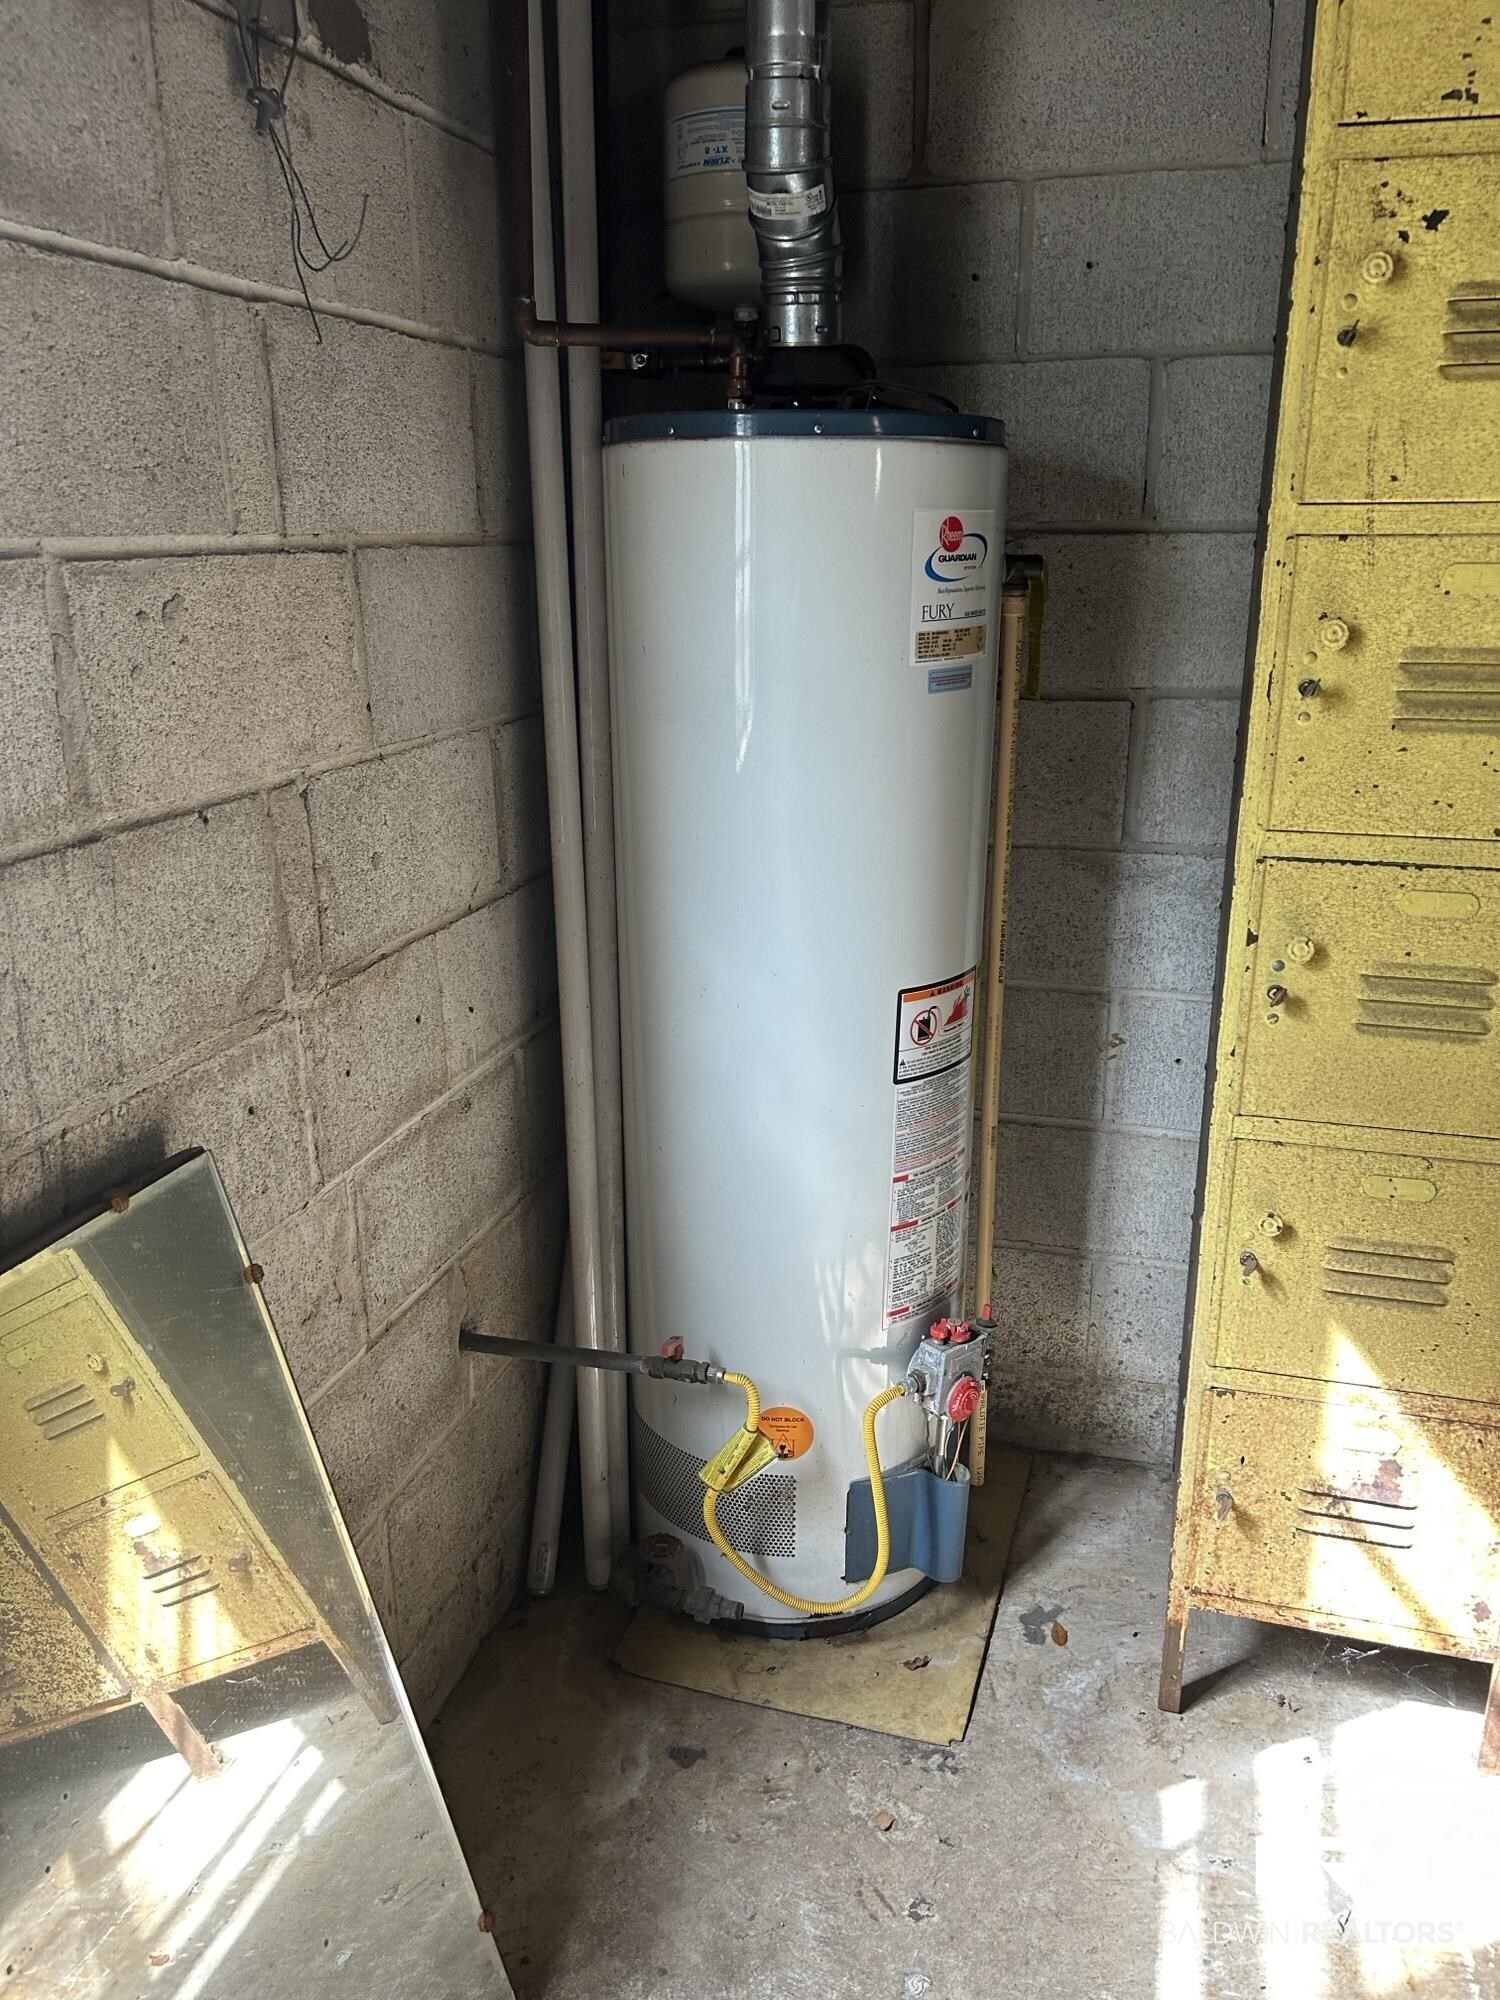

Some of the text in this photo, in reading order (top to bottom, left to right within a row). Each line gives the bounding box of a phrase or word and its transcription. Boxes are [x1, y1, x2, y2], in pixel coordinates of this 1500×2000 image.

[703, 157, 731, 168] ZURN
[941, 518, 963, 546] Rheem
[938, 552, 977, 563] GUARDIAN
[921, 603, 955, 621] FURY
